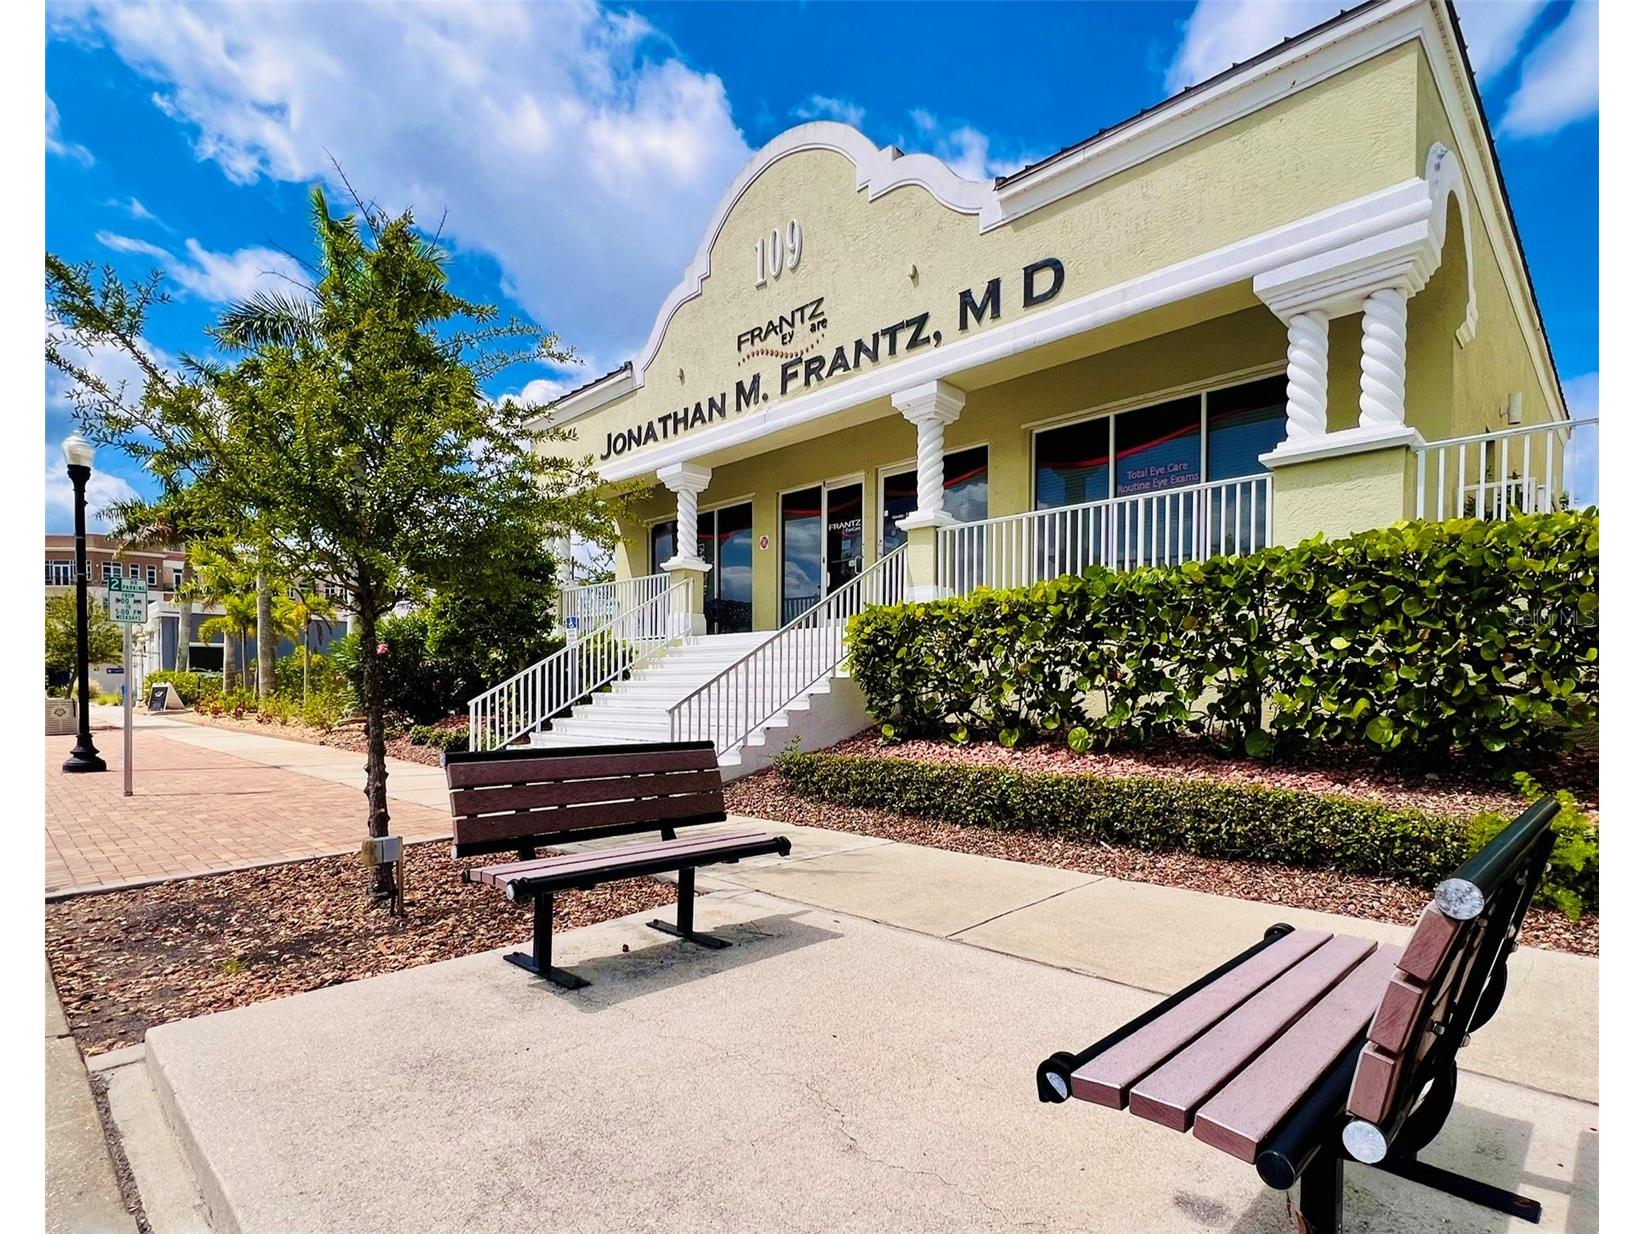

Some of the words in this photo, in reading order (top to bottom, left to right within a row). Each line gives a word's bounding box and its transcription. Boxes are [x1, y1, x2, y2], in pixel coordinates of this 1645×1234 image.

[754, 219, 803, 287] 109
[737, 297, 825, 352] FRANTZ
[809, 318, 828, 333] are
[600, 392, 727, 461] JONATHAN
[735, 372, 769, 412] M.
[958, 277, 1001, 333] M
[1022, 257, 1065, 309] D
[1127, 466, 1148, 480] Total
[1150, 465, 1166, 477] Eye
[1167, 462, 1189, 473] Care
[1117, 481, 1151, 494] Routine
[1152, 478, 1168, 489] Eye
[1170, 472, 1200, 484] Exams
[828, 519, 861, 531] FRANTZ
[111, 578, 119, 590] 2
